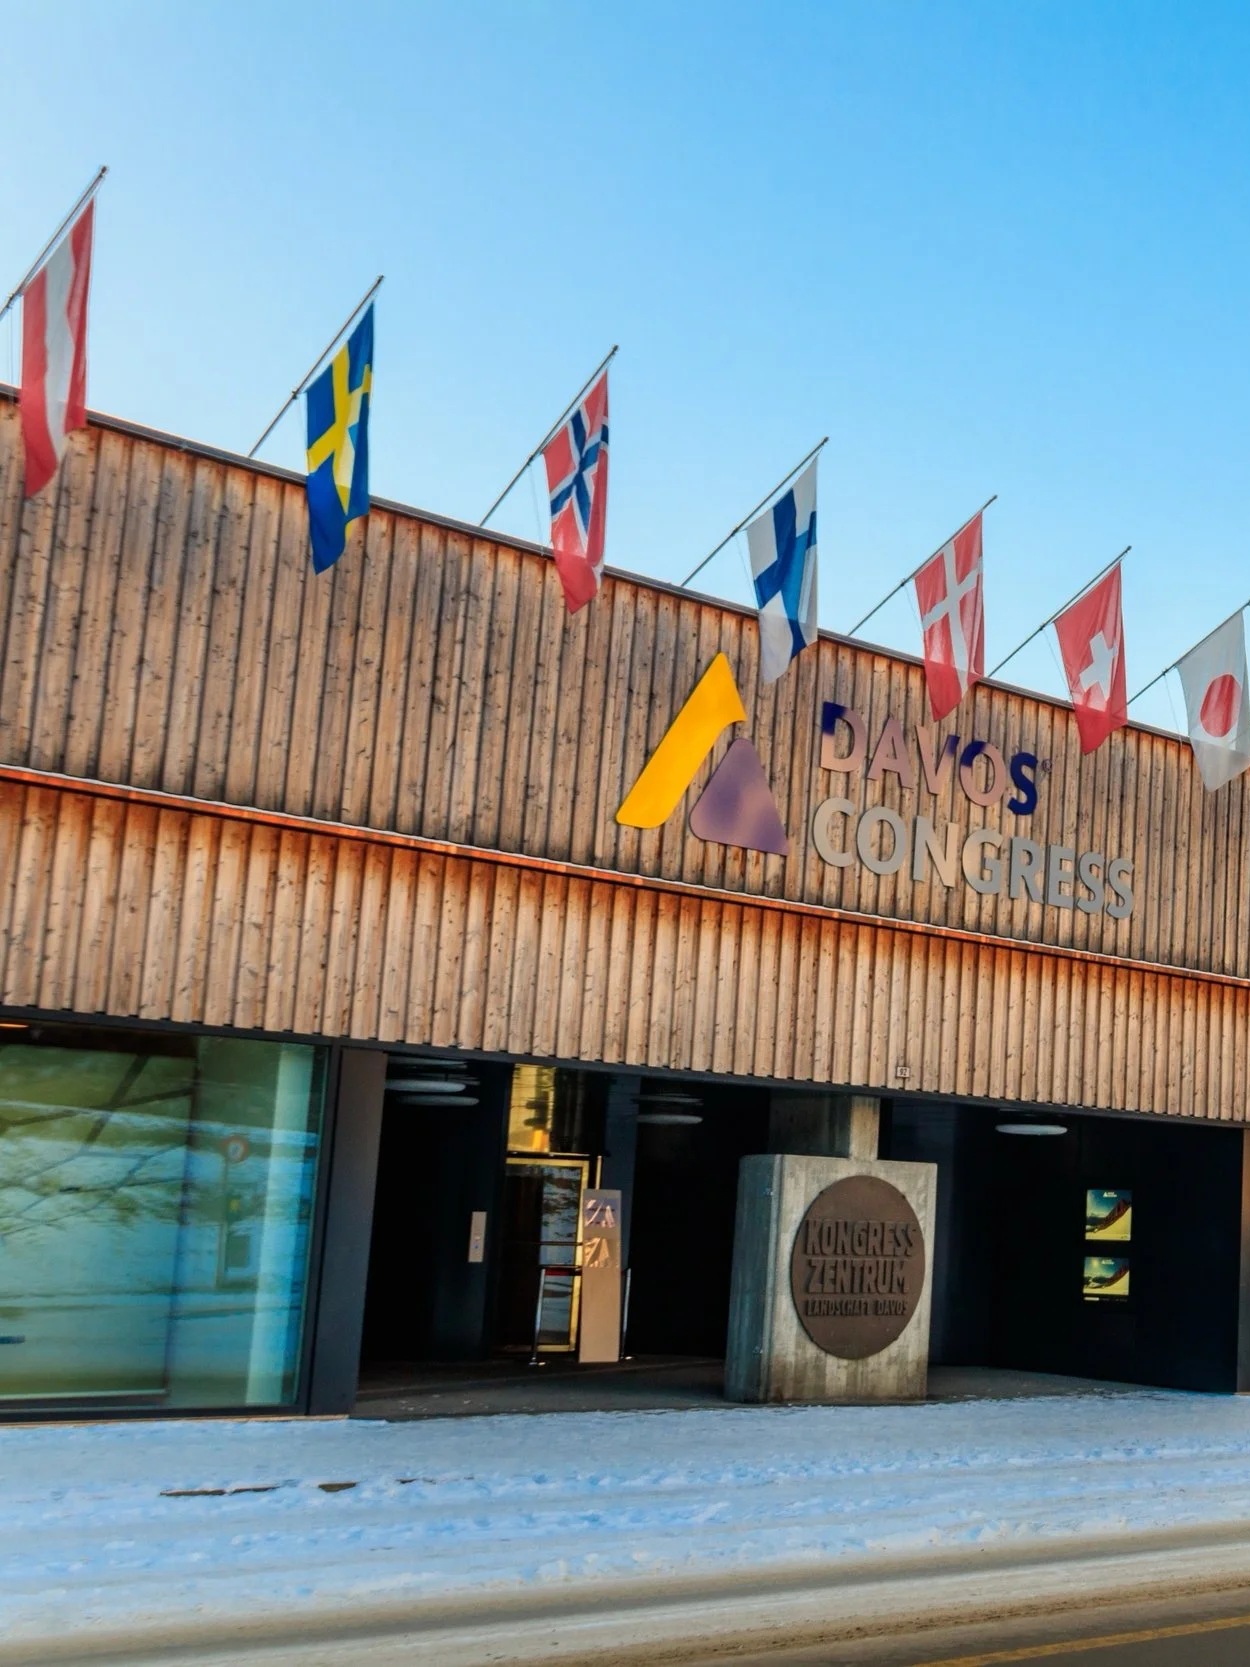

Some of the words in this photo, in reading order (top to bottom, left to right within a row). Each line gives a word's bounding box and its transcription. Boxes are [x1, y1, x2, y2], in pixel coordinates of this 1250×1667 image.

[820, 701, 1038, 816] DAVOS
[812, 797, 1135, 919] CONGRESS
[804, 1220, 915, 1257] KONGRESS
[805, 1257, 909, 1295] ZENTRUM
[875, 1299, 908, 1317] DAVOS
